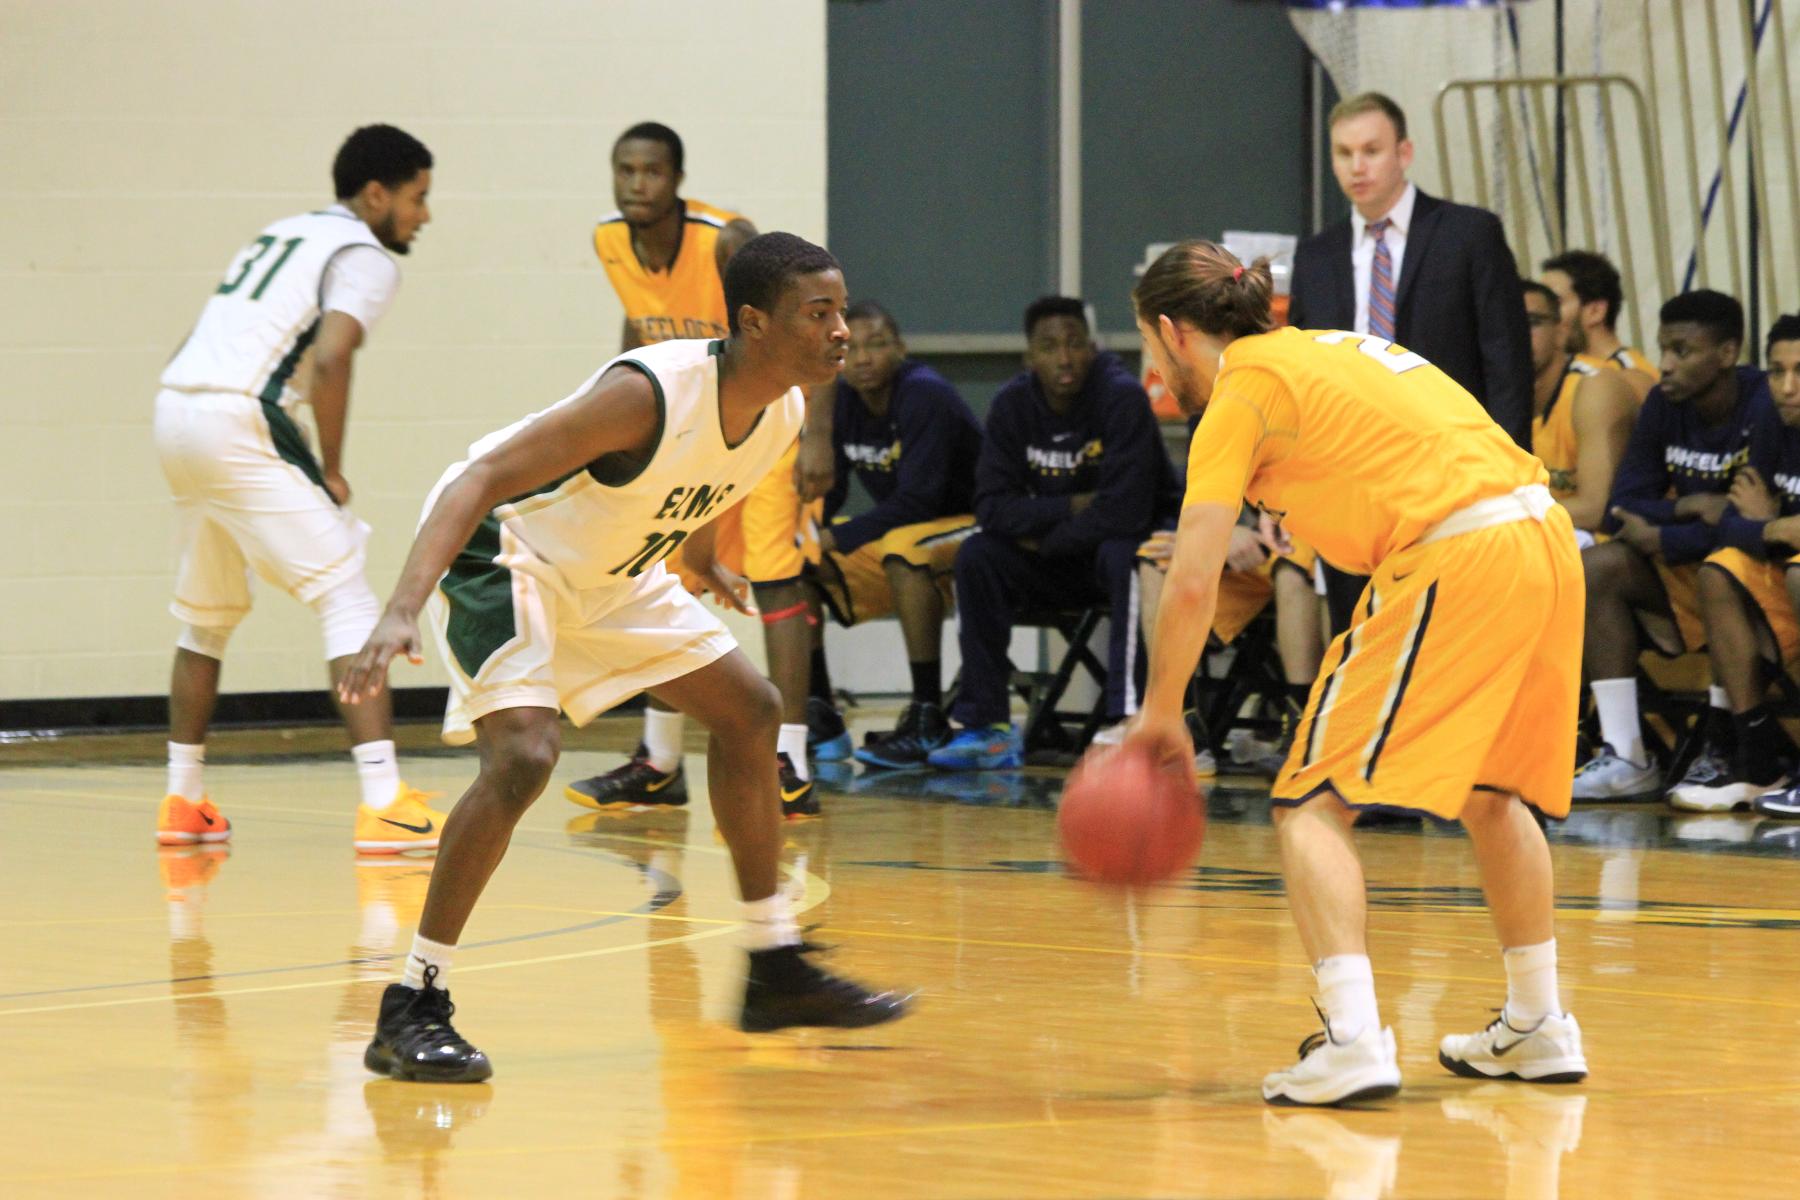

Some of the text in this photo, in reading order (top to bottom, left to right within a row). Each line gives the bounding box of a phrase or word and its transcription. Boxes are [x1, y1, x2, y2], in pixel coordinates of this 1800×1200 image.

[216, 235, 304, 301] 31
[1312, 331, 1431, 375] 2
[654, 484, 735, 521] ELMS
[607, 530, 688, 577] 10
